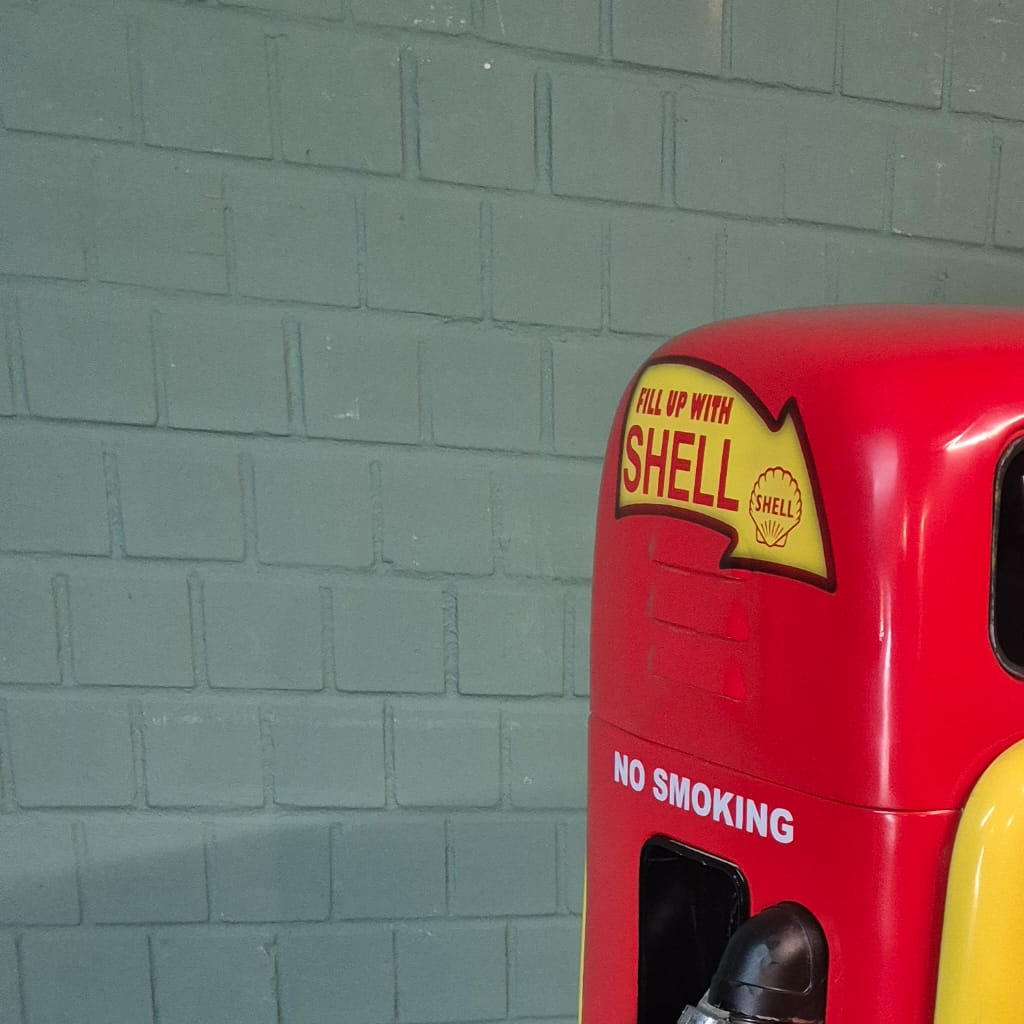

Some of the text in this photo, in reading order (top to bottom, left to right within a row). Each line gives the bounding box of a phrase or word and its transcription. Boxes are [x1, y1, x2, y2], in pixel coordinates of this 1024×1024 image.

[636, 387, 734, 425] FILL UP WITH
[623, 425, 739, 512] SHELL
[755, 494, 794, 518] SHELL
[613, 751, 794, 844] NO SMOKING
